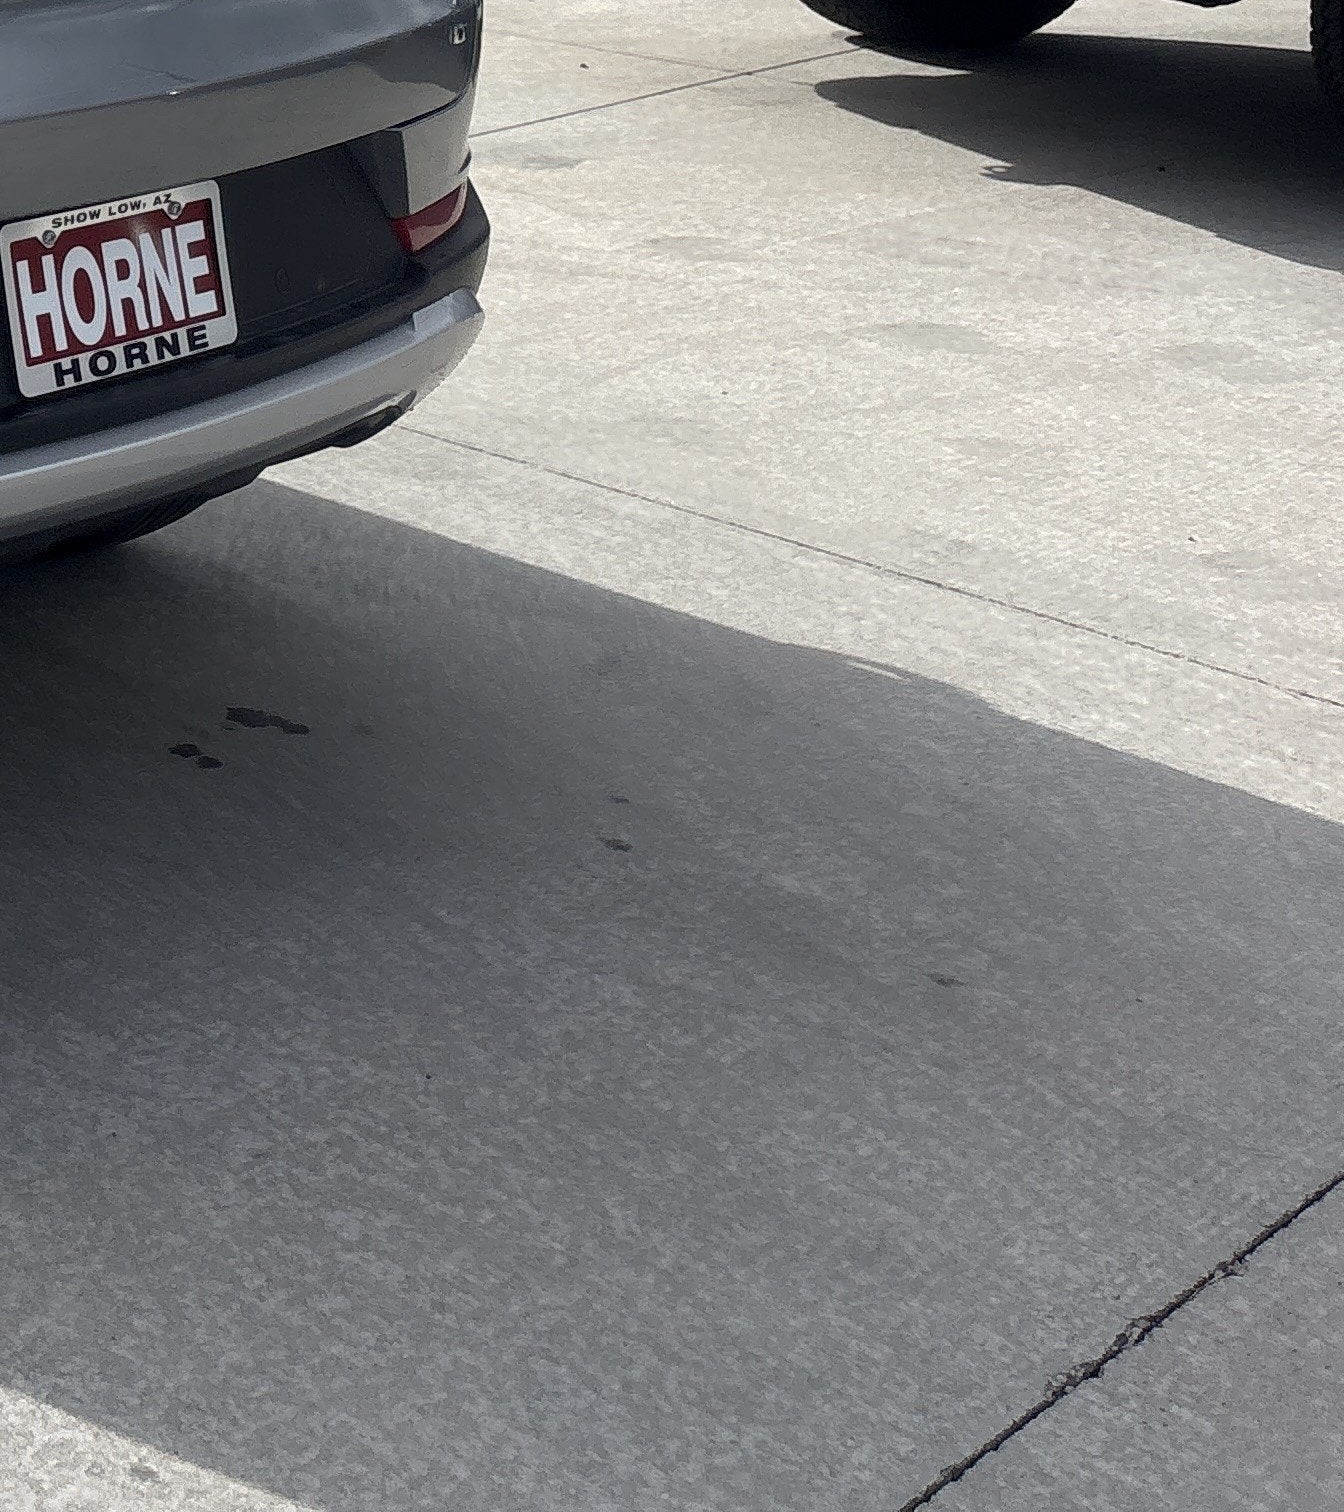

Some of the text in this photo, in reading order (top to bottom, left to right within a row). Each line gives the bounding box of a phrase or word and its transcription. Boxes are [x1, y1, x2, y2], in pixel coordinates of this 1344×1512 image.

[50, 192, 173, 229] SHOW LOW, AZ
[15, 219, 219, 359] HORNE
[52, 324, 210, 388] HORNE
